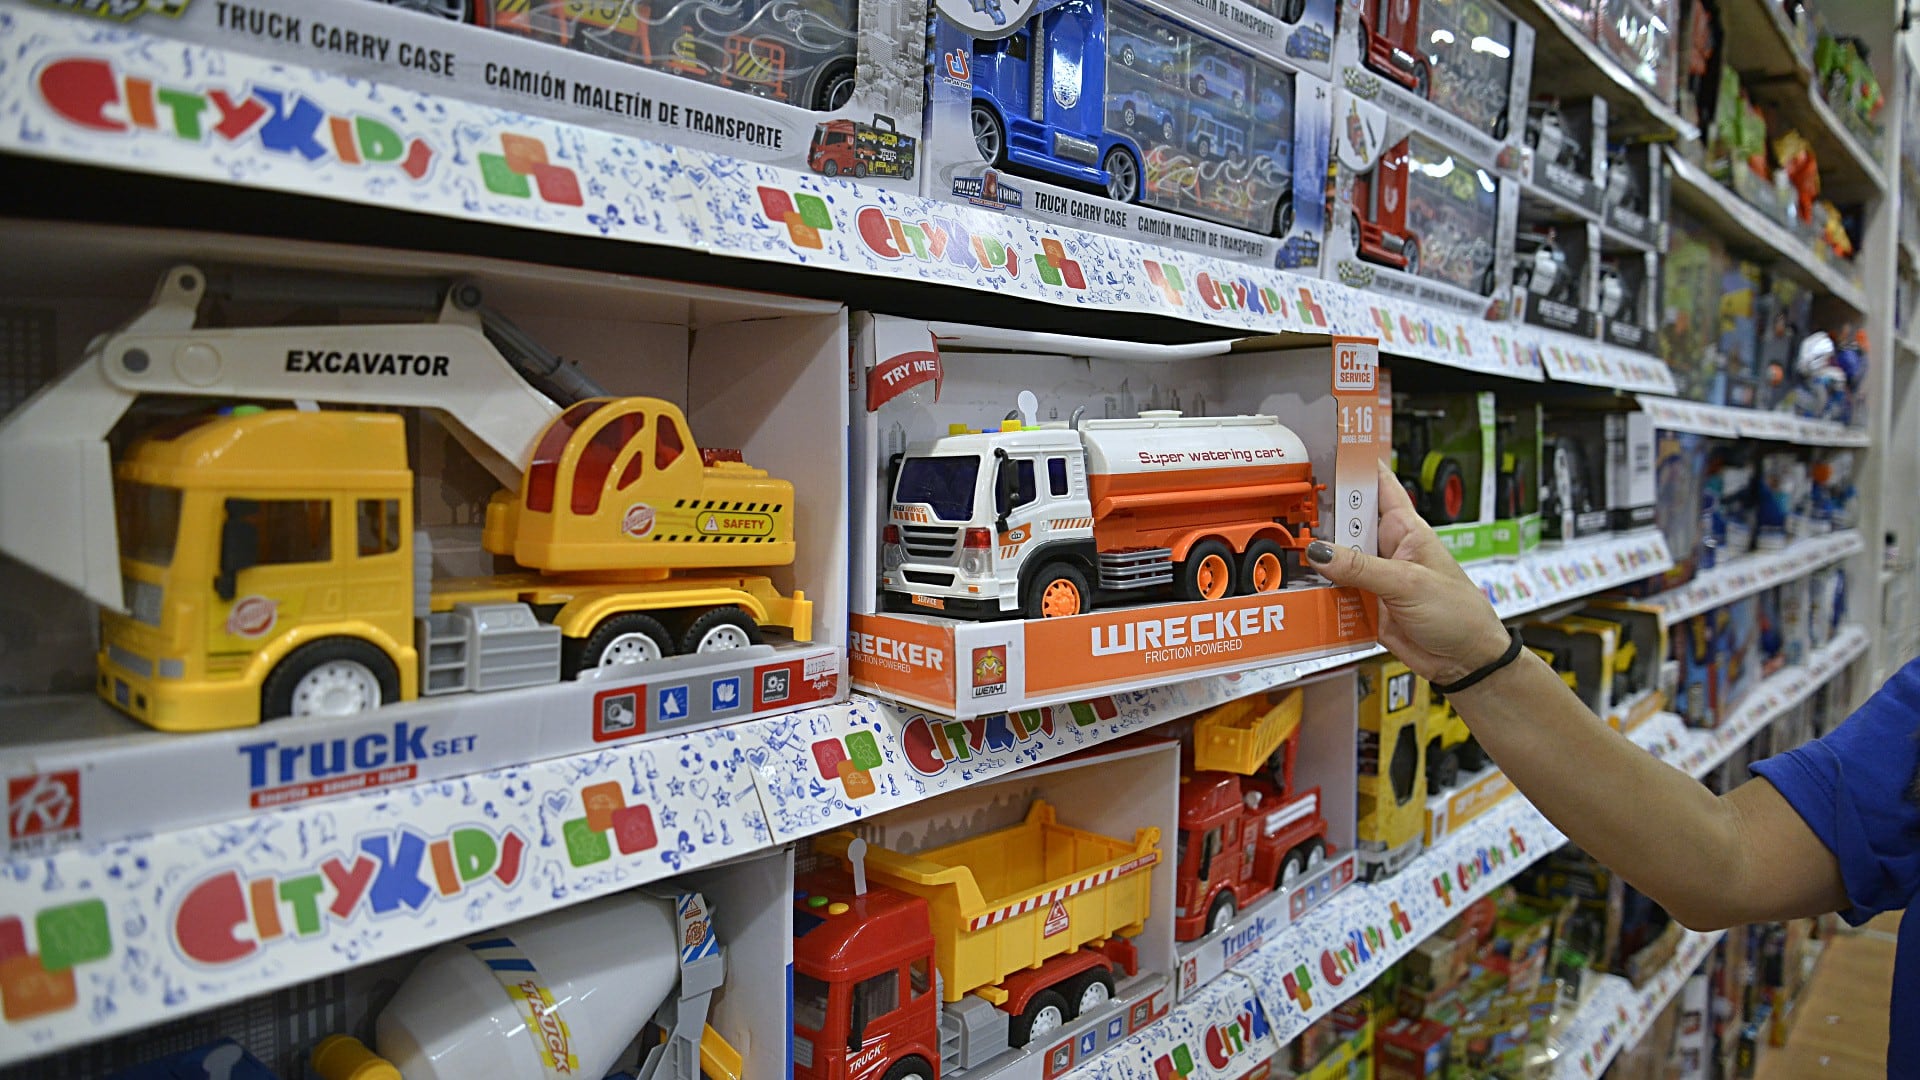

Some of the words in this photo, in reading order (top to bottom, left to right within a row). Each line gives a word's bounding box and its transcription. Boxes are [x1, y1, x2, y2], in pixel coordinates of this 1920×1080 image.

[216, 2, 301, 43] TRUCK
[311, 23, 390, 62] CARRY
[398, 43, 456, 76] CASE
[1231, 6, 1274, 39] TRANSPORTE
[38, 57, 434, 180] CITYKIDS
[485, 62, 566, 100] CAMIÓN
[573, 83, 652, 119] MALETÍN
[658, 102, 679, 126] DE
[685, 108, 783, 149] TRANSPORTE
[954, 180, 981, 196] POLICE
[1034, 191, 1067, 215] TRUCK
[1070, 200, 1101, 222] CARRY
[1103, 208, 1127, 228] CASE
[857, 206, 1019, 278] CITYKIDS
[1138, 216, 1172, 237] CAMIÓN
[1208, 231, 1218, 247] DE
[1220, 234, 1264, 257] TRANSPORTE
[1196, 271, 1288, 319] CITYKIDS
[285, 350, 450, 376] EXCAVATOR
[882, 362, 911, 386] TRY
[913, 360, 936, 373] ME
[1340, 372, 1371, 383] SERVICE
[1342, 406, 1373, 433] 1:16
[1138, 451, 1185, 467] Super
[1188, 448, 1253, 463] watering
[1254, 447, 1285, 459] cart
[723, 518, 765, 529] SAFETY
[1090, 603, 1285, 657] WRECKER
[850, 631, 944, 672] RECKER
[850, 652, 878, 667] FRICTION
[878, 658, 911, 674] POWERED
[1144, 645, 1193, 664] FRICTION
[1194, 638, 1243, 657] POWERED
[812, 680, 829, 690] Ages
[975, 685, 1004, 697] WENYI
[238, 721, 429, 789] Truck
[432, 734, 478, 758] SET
[174, 827, 525, 965] CITYKIDS
[1221, 917, 1265, 959] Truck
[518, 979, 571, 1075] TRUCK
[849, 1043, 883, 1074] TRUCK
